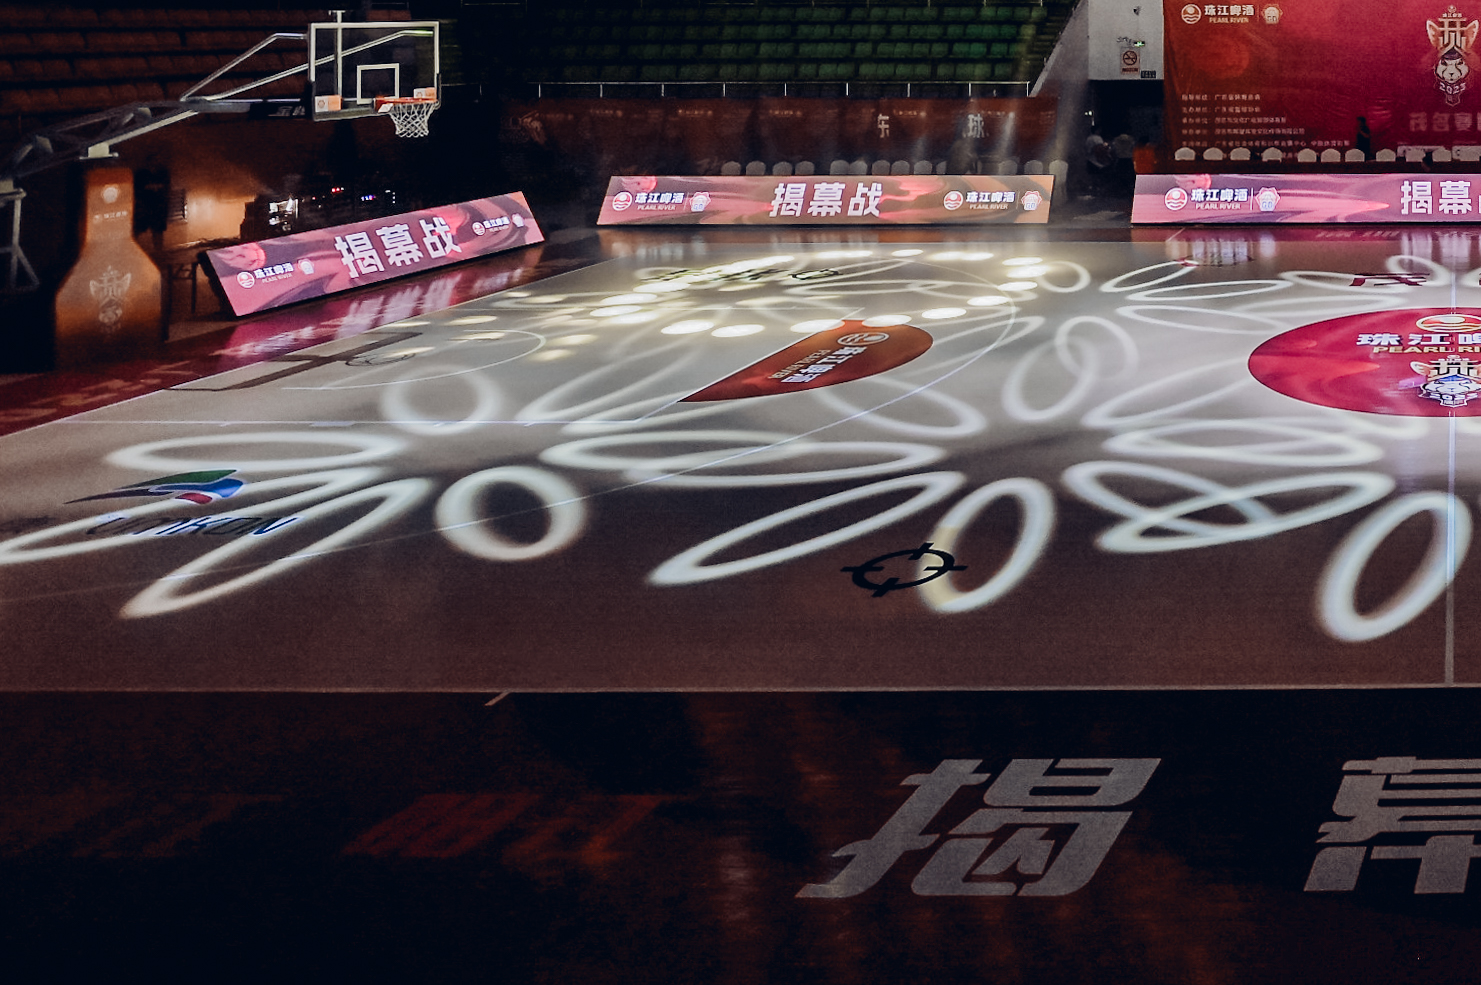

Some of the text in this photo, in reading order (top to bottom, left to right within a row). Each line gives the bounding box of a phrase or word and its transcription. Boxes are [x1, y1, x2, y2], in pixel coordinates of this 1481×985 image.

[1204, 4, 1255, 16] 珠江啤酒
[634, 192, 684, 204] 珠江啤酒
[769, 182, 883, 218] 揭幕战
[966, 192, 1015, 204] 珠江啤酒
[1190, 188, 1248, 201] 珠江啤酒
[334, 216, 462, 279] 揭幕战
[1373, 346, 1456, 354] PEARL
